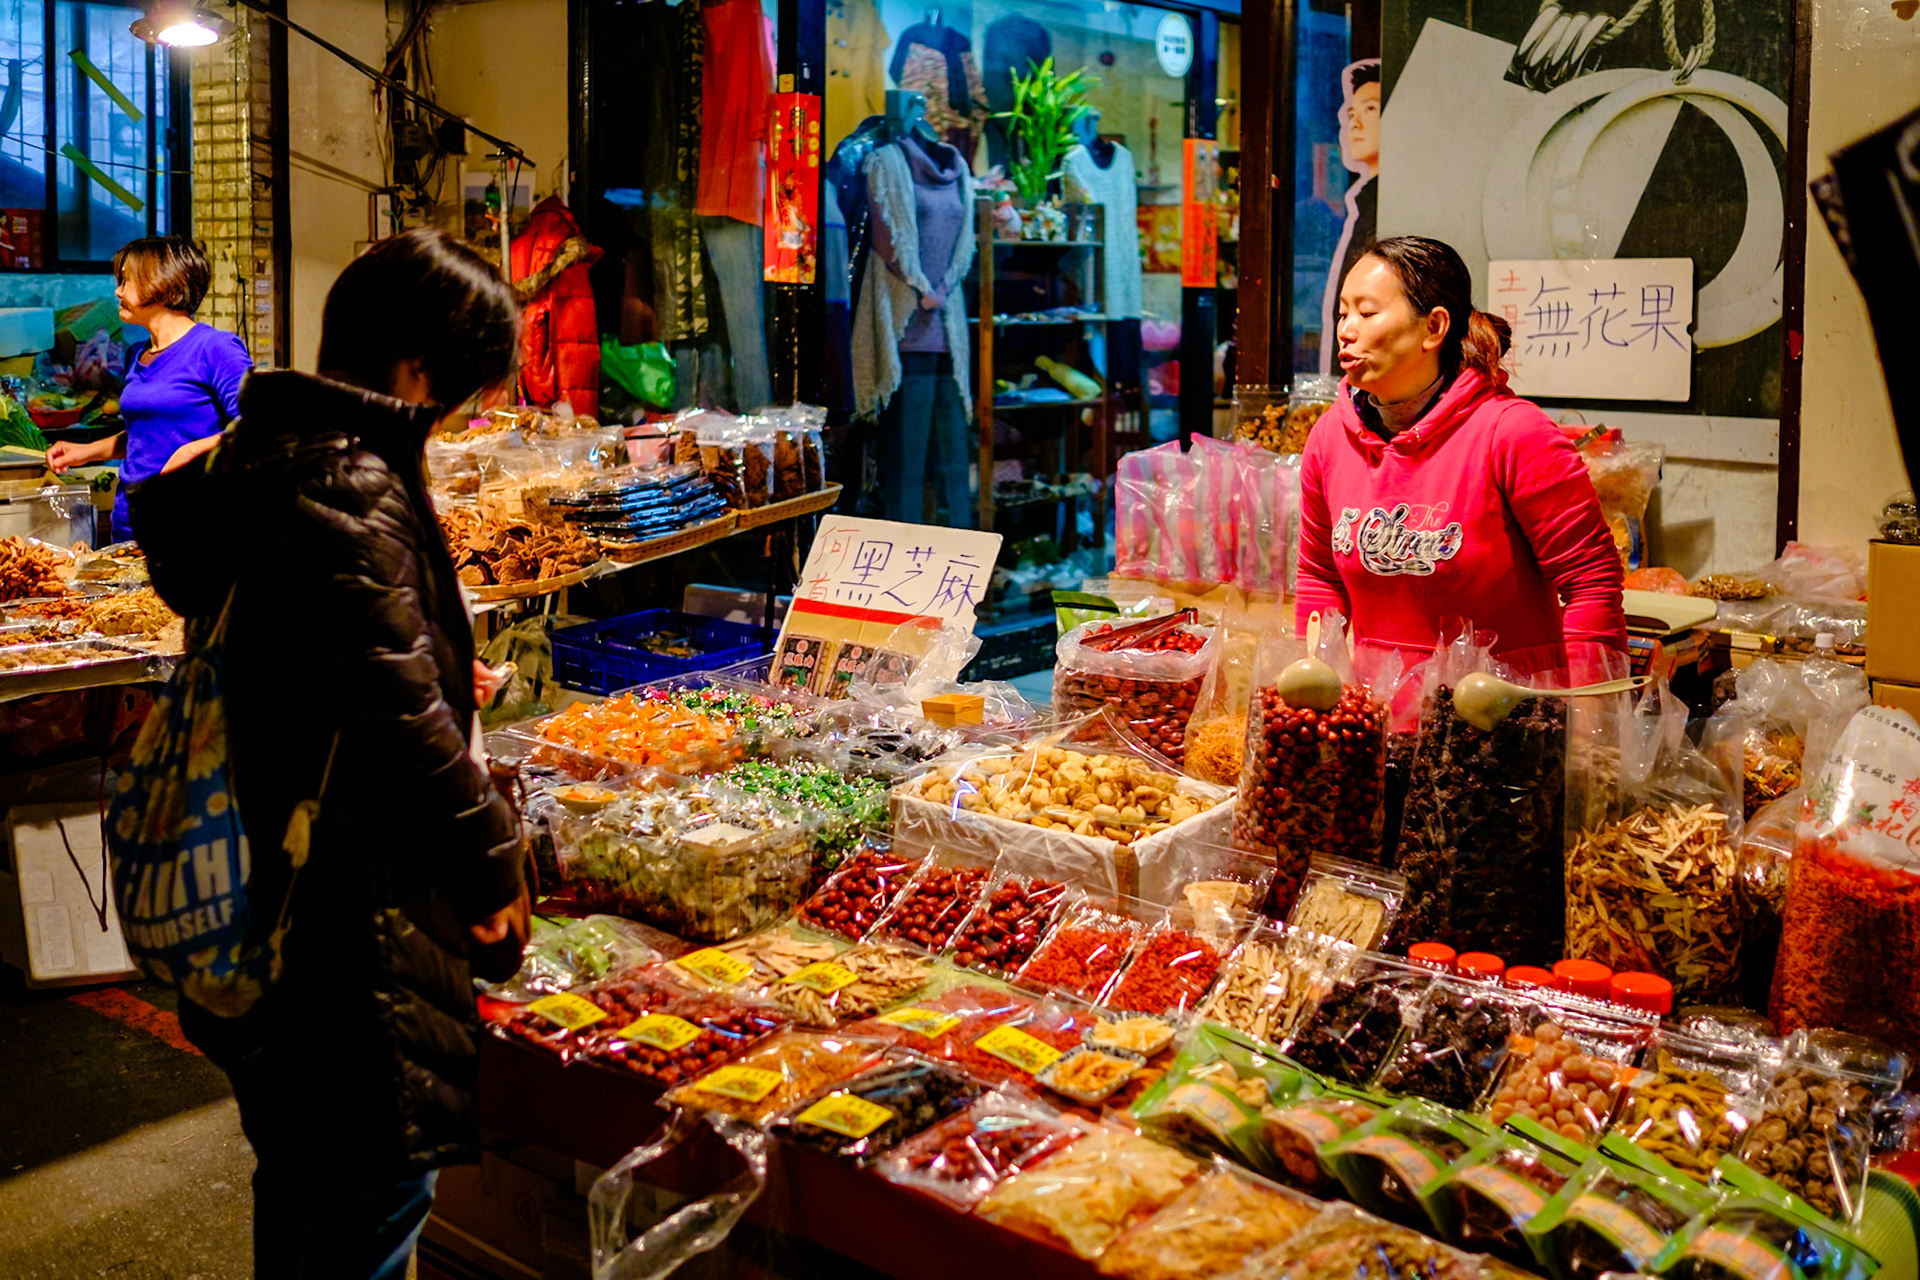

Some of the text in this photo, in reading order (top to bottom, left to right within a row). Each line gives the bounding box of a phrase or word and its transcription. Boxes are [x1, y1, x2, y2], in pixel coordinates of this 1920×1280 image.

[1524, 275, 1688, 358] 無花果
[1410, 501, 1449, 530] The
[834, 540, 981, 617] 黑芝麻
